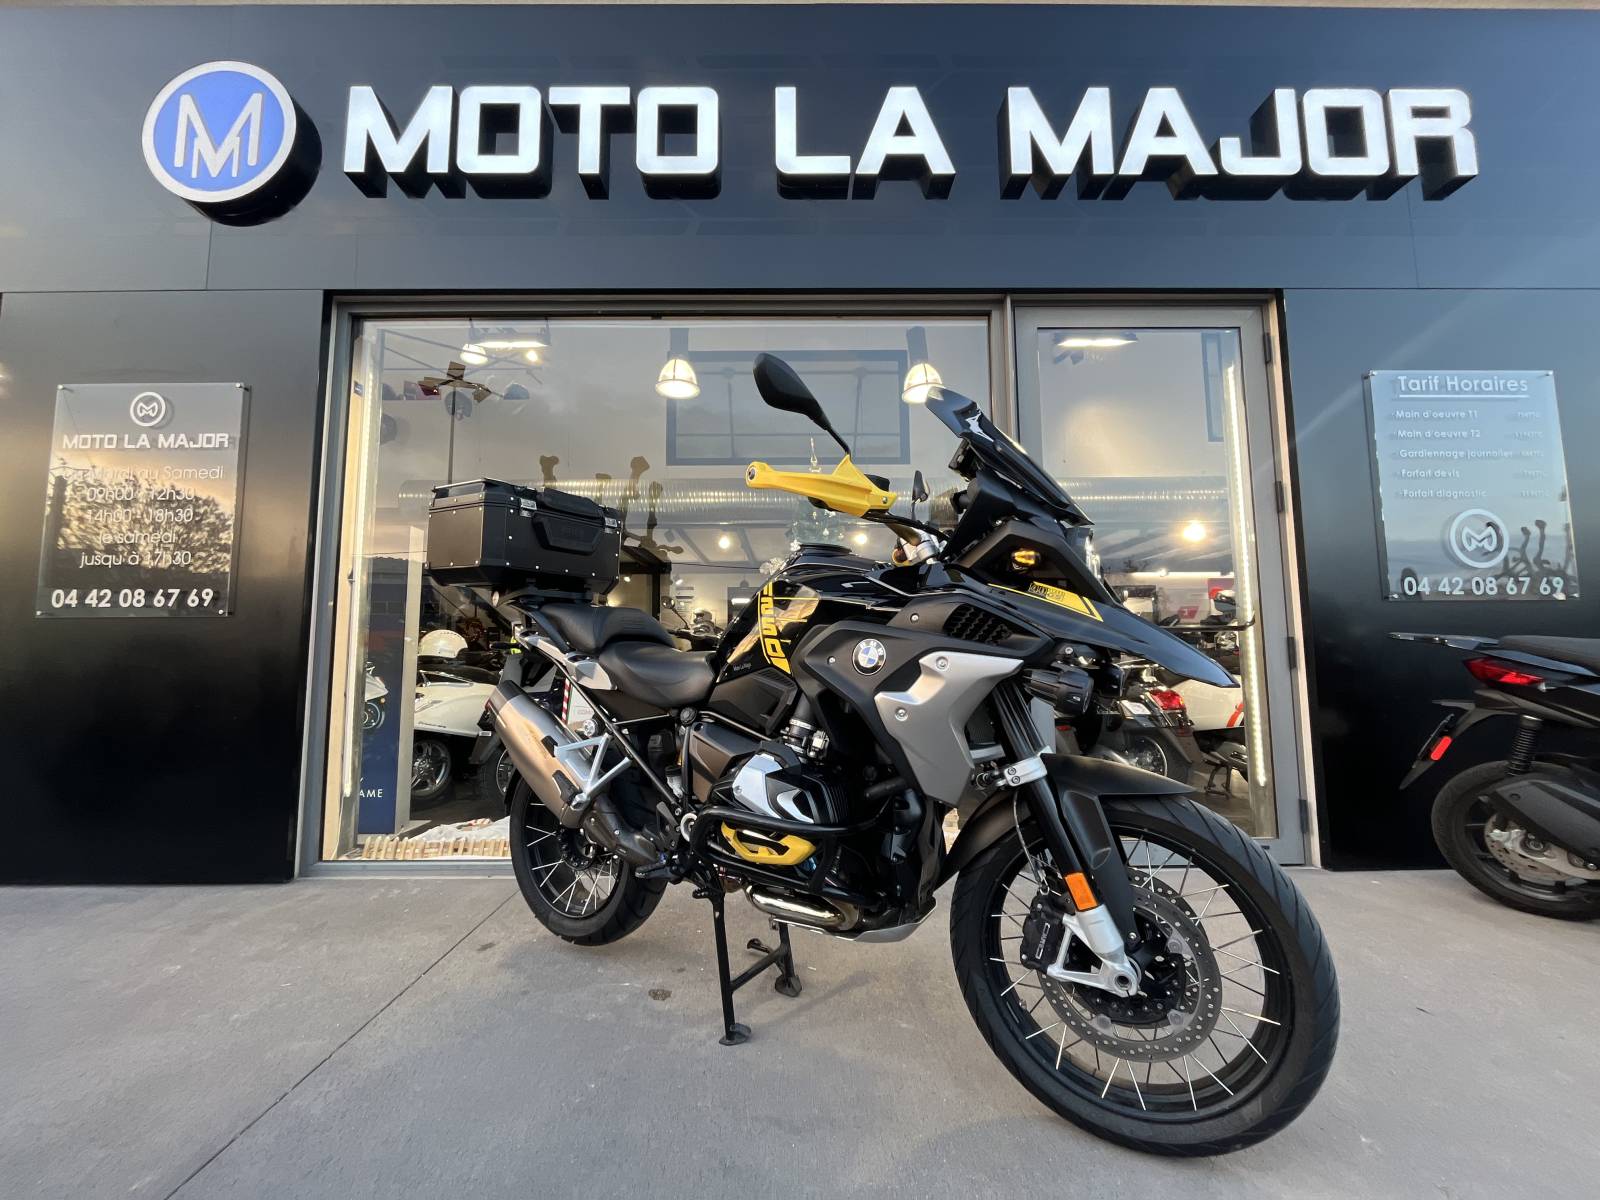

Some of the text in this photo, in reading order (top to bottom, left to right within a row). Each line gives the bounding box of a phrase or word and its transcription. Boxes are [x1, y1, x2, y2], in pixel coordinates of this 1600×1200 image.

[343, 85, 1479, 176] MOTO LA MAJOR
[1397, 375, 1528, 392] Tarif Horaires
[1395, 409, 1420, 418] Main
[1422, 409, 1466, 418] d'oeuvre
[62, 432, 229, 449] MOTO LA MAJOR
[1397, 428, 1422, 438] Main
[1424, 428, 1468, 438] d'oeuvre
[1399, 449, 1465, 460] Gardiennage
[163, 464, 224, 480] Samedi
[1401, 468, 1460, 478] Forfait devis
[87, 487, 195, 501] 09h00 12h30
[1403, 488, 1487, 499] Forfait diagnostic
[87, 508, 132, 522] 14h00
[148, 508, 193, 522] 18h30
[116, 529, 176, 544] samedi
[79, 550, 192, 568] jusquà 17h30
[1403, 576, 1564, 595] 04 42 08 67 69
[51, 587, 214, 608] 04 42 08 67 69
